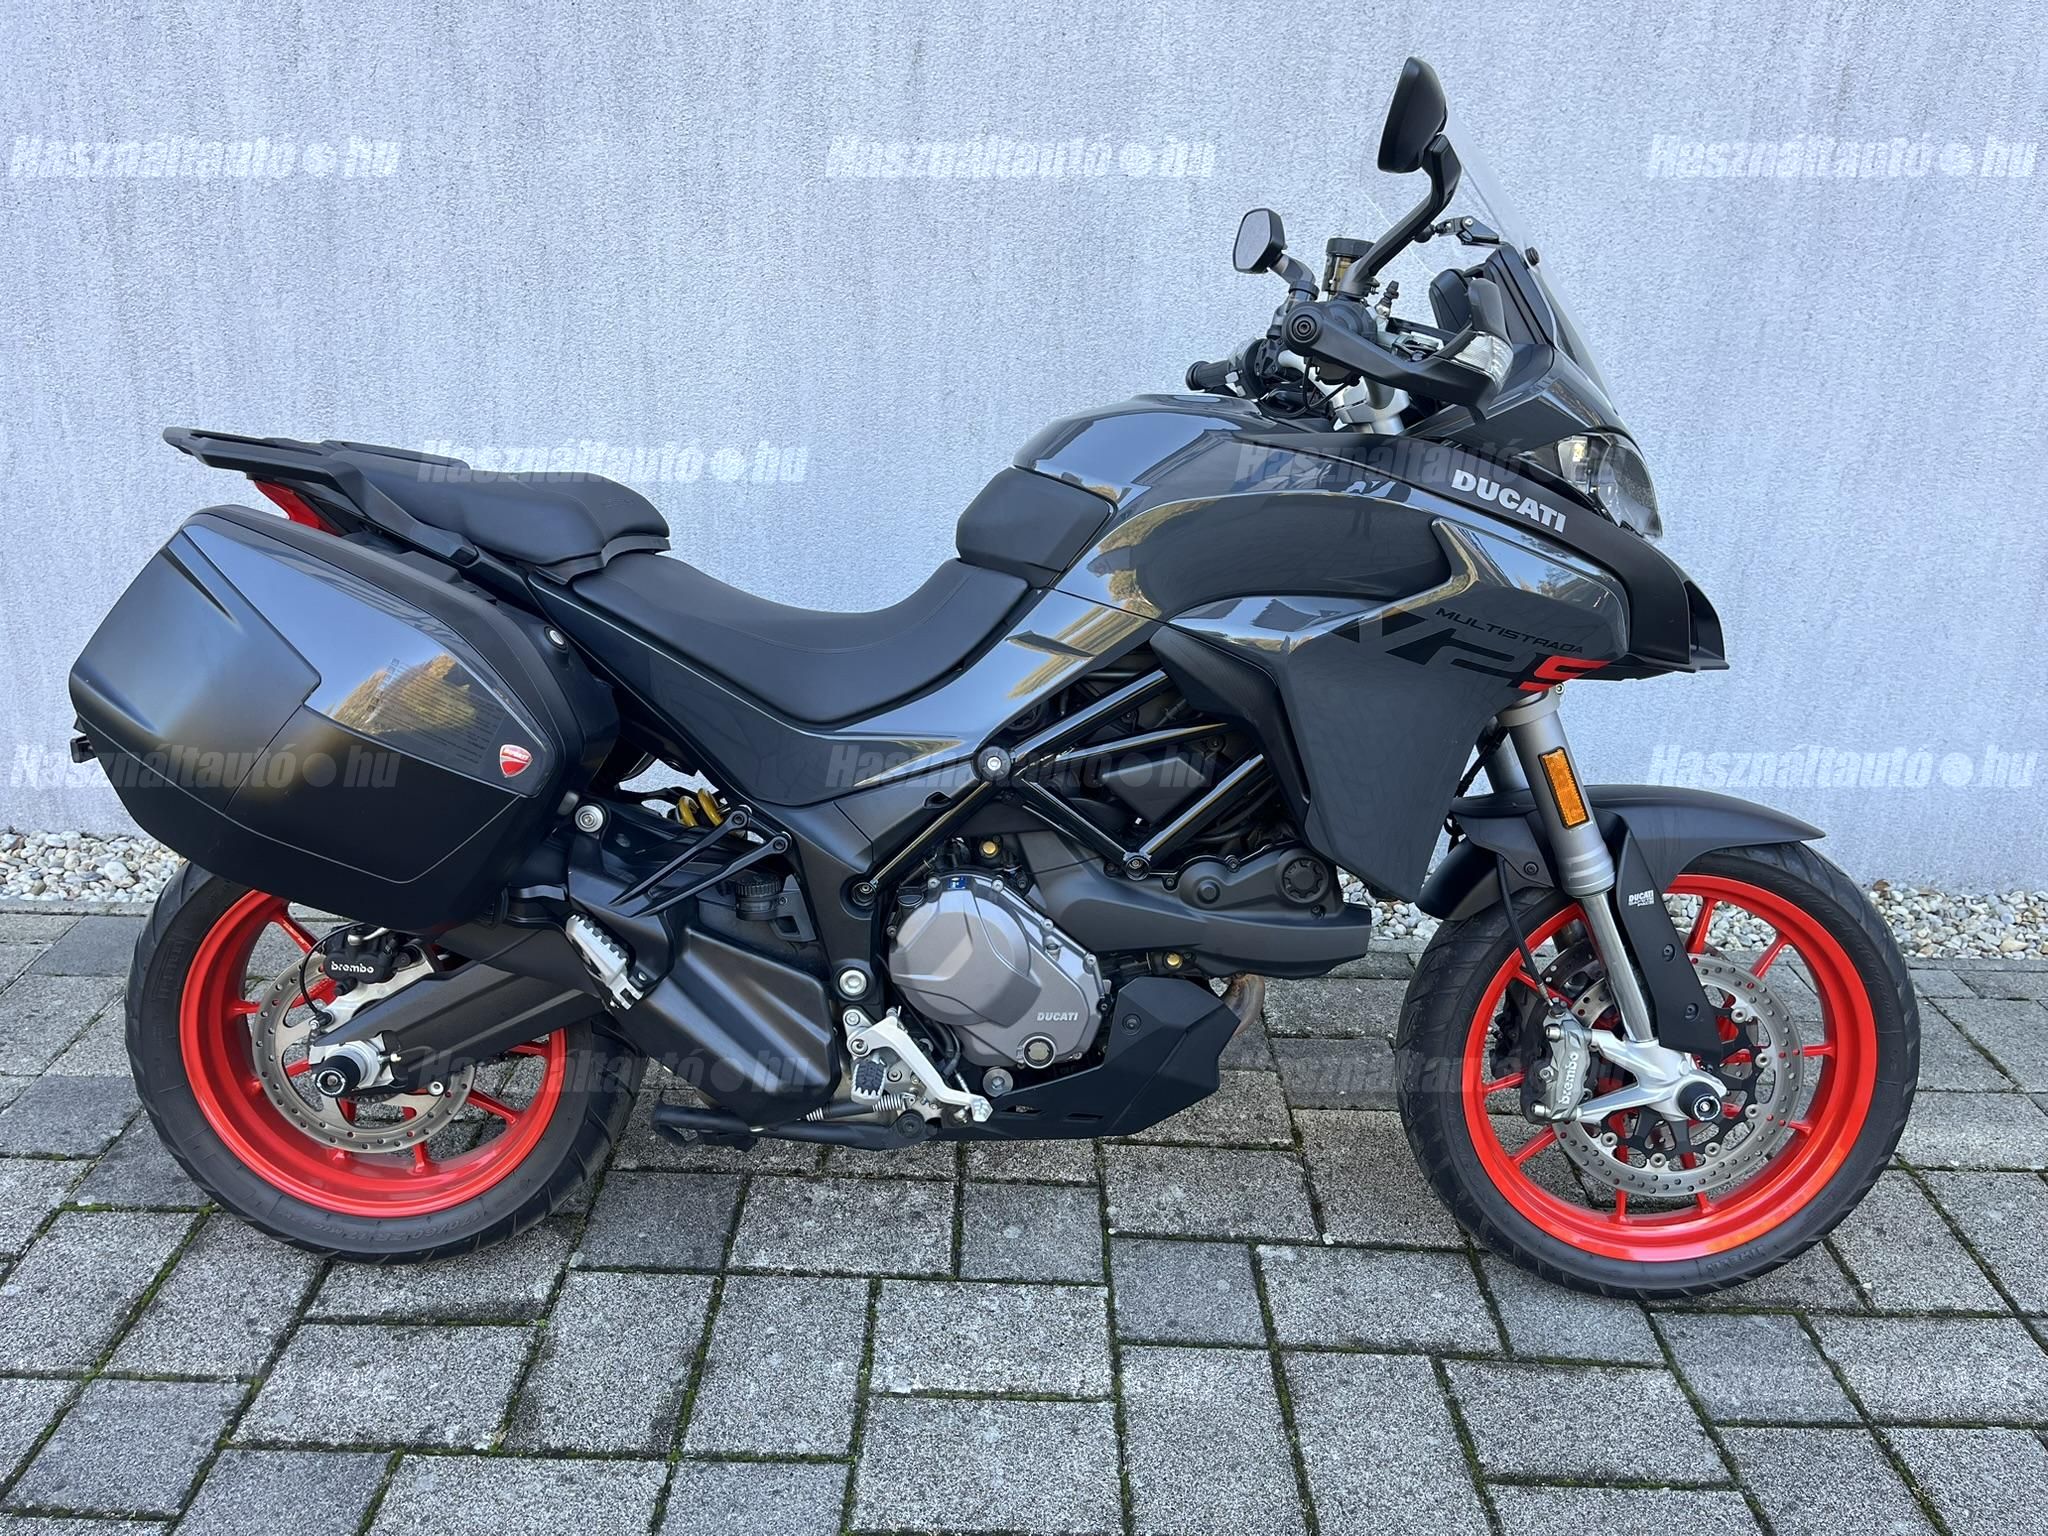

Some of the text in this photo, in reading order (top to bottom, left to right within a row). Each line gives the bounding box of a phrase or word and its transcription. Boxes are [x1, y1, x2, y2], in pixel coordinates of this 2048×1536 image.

[1451, 469, 1567, 533] DUCATI
[1436, 607, 1584, 654] MULTISTRADA
[1628, 890, 1654, 902] DUCATI
[331, 961, 374, 974] brembo
[1036, 1011, 1079, 1021] DUCATI
[1558, 1052, 1579, 1105] brembo
